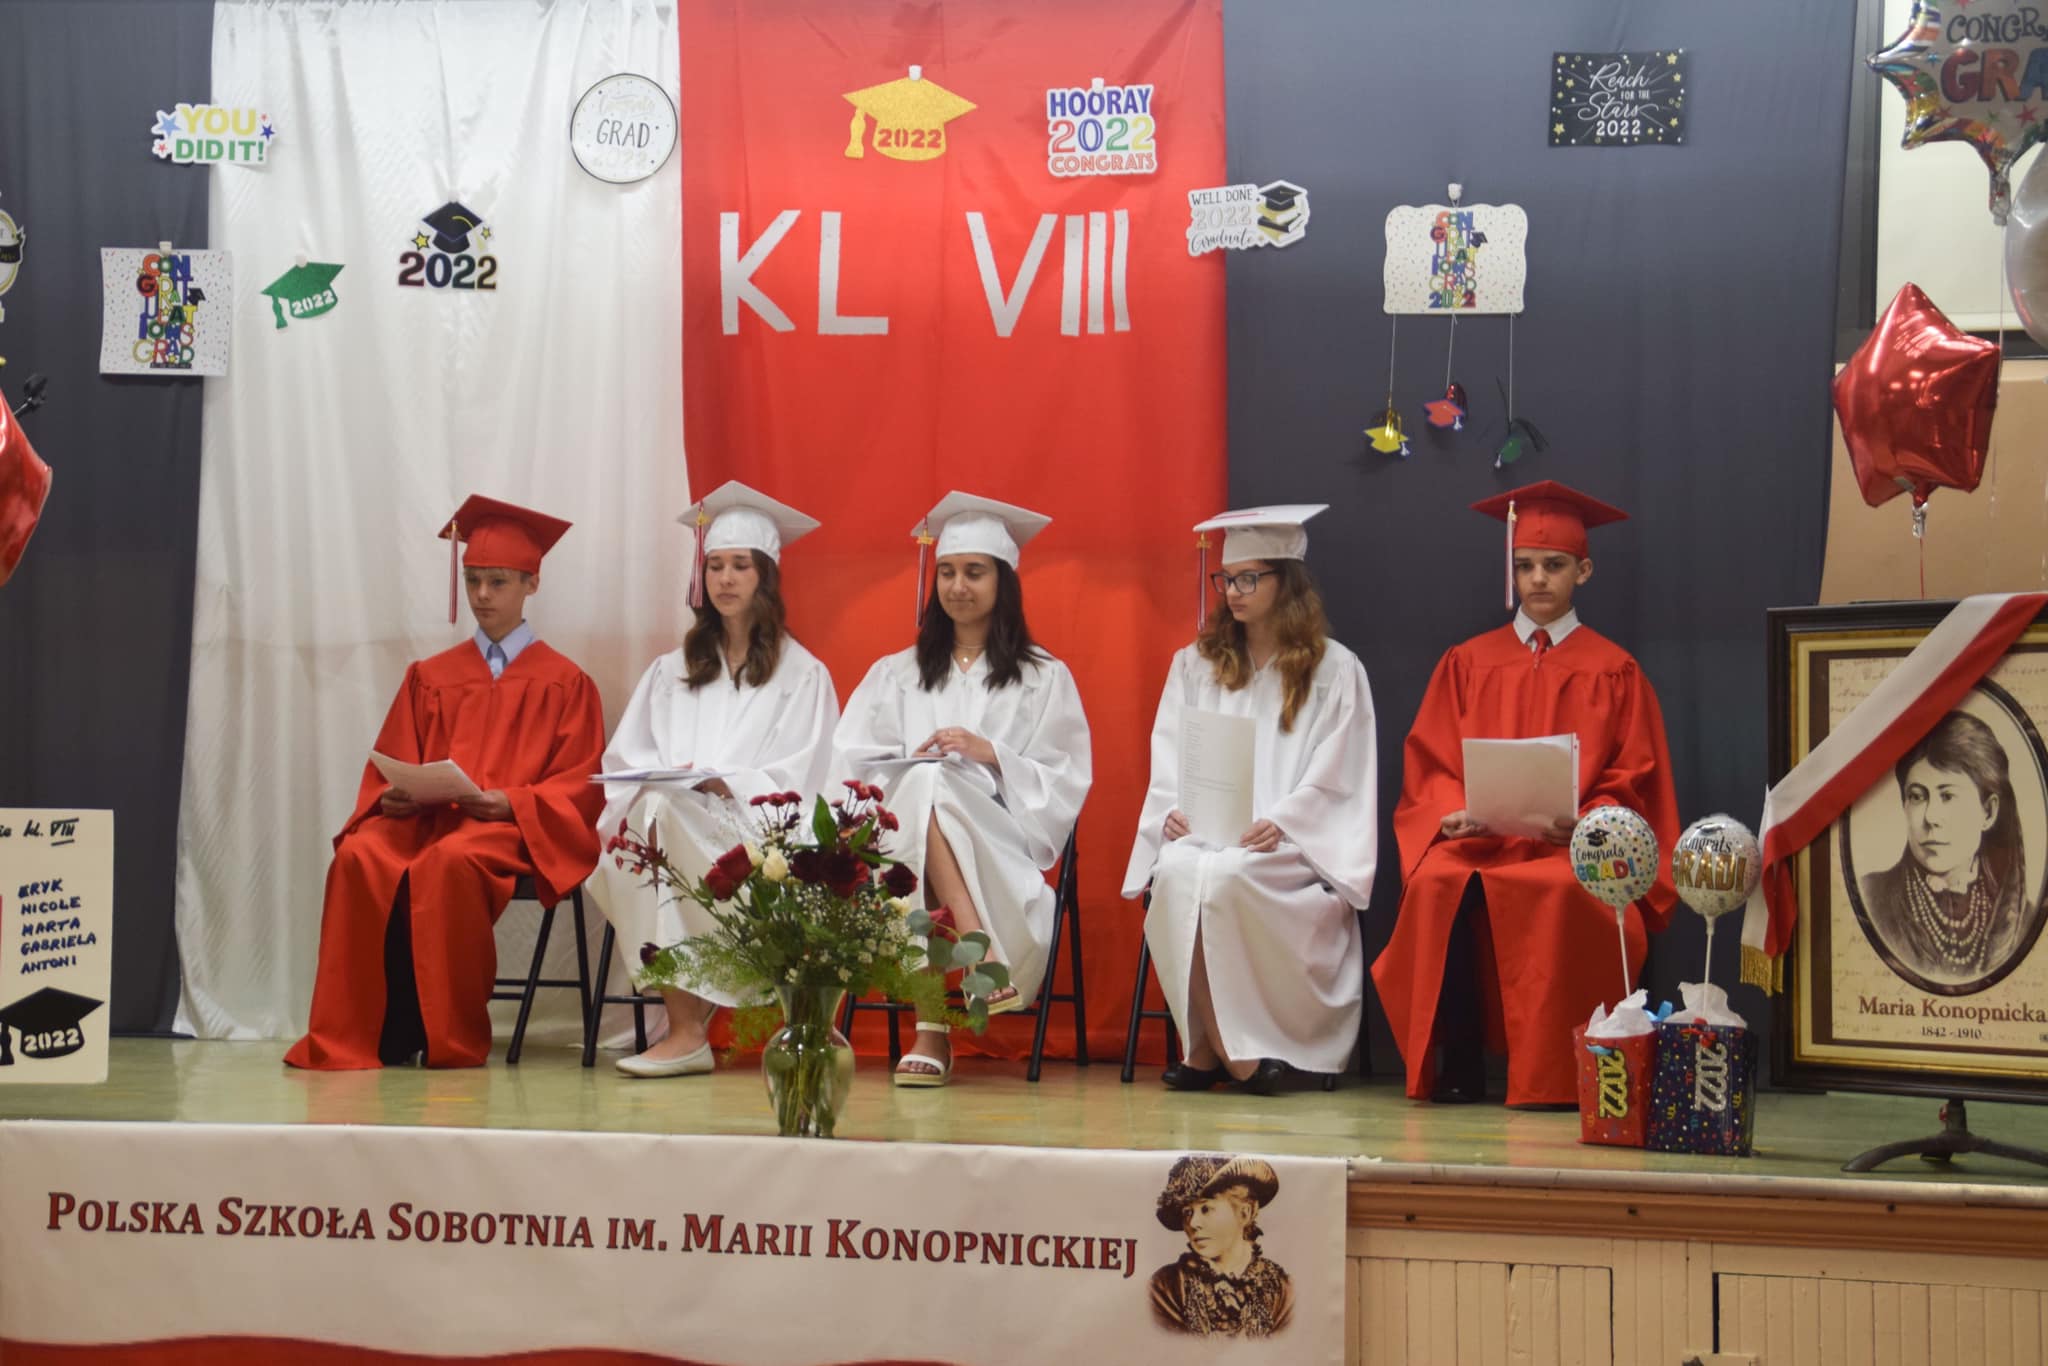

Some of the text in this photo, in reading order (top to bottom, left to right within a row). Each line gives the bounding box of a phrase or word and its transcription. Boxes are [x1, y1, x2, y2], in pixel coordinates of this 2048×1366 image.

[1589, 62, 1649, 93] Reach
[1050, 88, 1151, 117] HOORAY
[1577, 91, 1659, 121] Stars
[1620, 89, 1650, 100] FOR THE
[180, 106, 257, 136] YOU
[1596, 119, 1641, 136] 2022
[596, 118, 650, 149] GRAD
[877, 127, 942, 149] 2022
[1052, 116, 1153, 153] 2022
[175, 139, 265, 161] DID IT!
[1051, 152, 1155, 173] CONGRATS
[1191, 187, 1254, 206] WELL DONE
[1193, 204, 1253, 231] 2022
[398, 251, 497, 290] 2022
[965, 208, 1131, 338] VIII
[291, 290, 336, 316] 2022
[1428, 289, 1476, 309] 2022
[1575, 844, 1625, 864] Congrats
[18, 878, 63, 899] ERYK
[20, 895, 81, 916] NICOLE
[21, 917, 81, 937] MARTA
[20, 932, 97, 956] GABRIELA
[20, 955, 77, 975] ANTONI
[1858, 996, 2047, 1025] Maria Konopnicka
[24, 1028, 80, 1052] 2022
[1921, 1026, 1947, 1037] 1842
[1956, 1028, 1982, 1040] 1910
[1597, 1048, 1629, 1119] 2022
[1696, 1041, 1728, 1113] 2022
[47, 1191, 204, 1235] POLSKA
[216, 1197, 375, 1240] SZKOŁA
[386, 1202, 595, 1248] SOBOTNIA
[680, 1213, 812, 1258] MARII
[825, 1219, 1138, 1279] KONOPNICKIEJ
